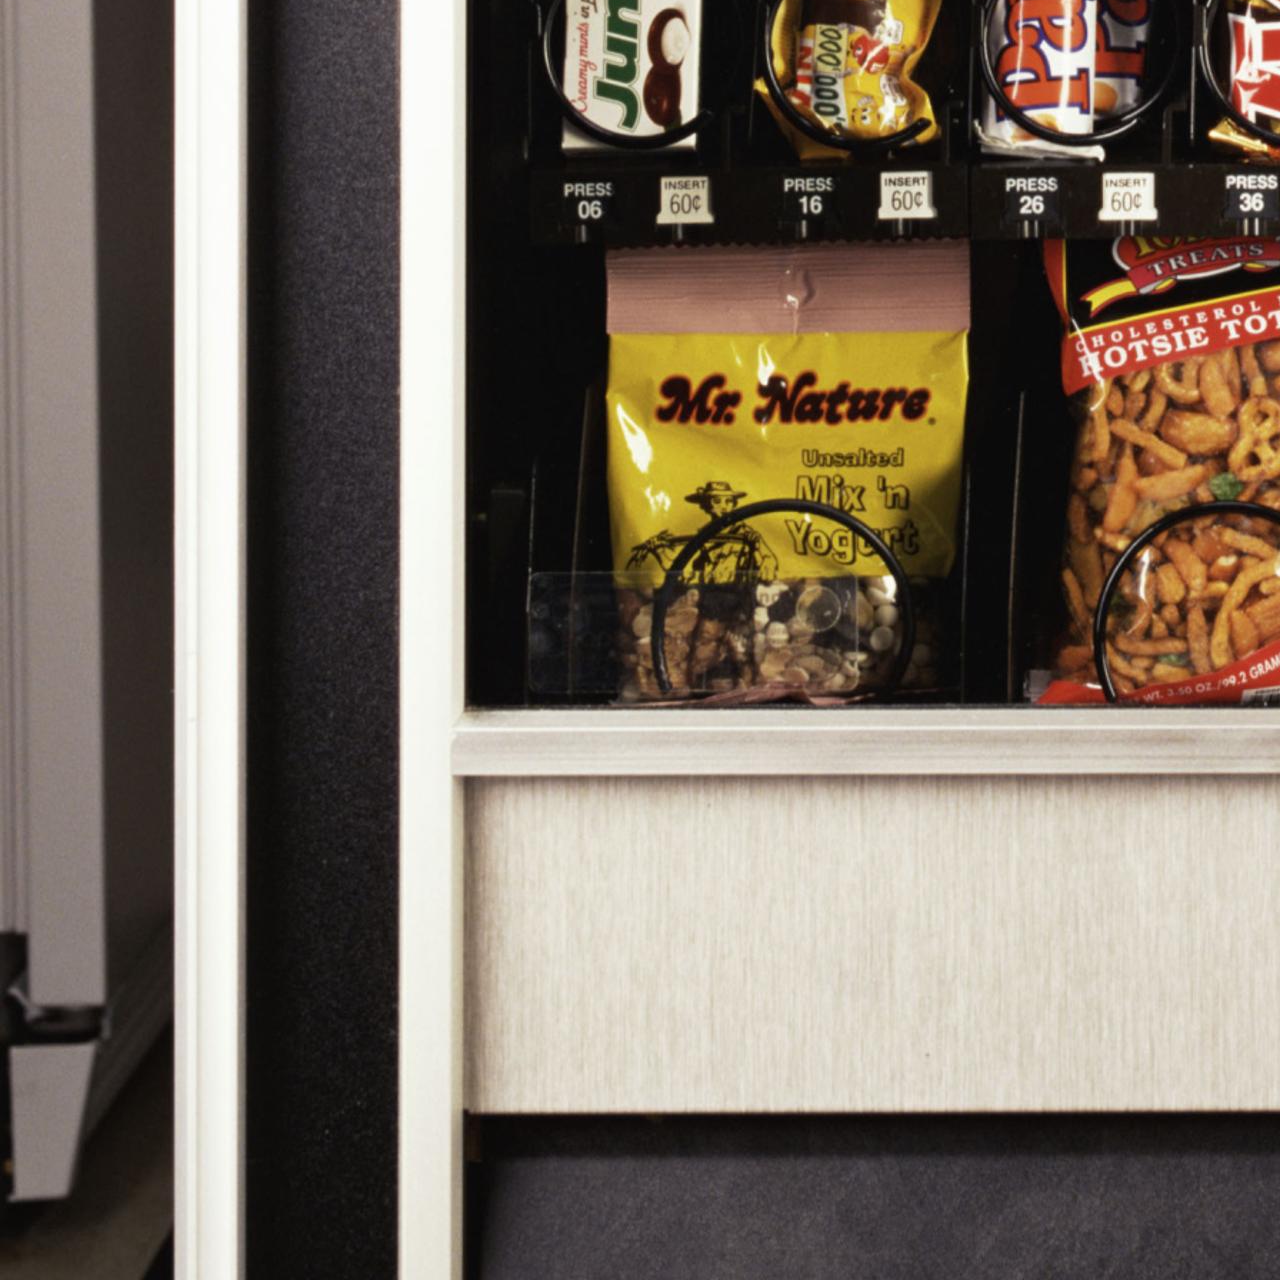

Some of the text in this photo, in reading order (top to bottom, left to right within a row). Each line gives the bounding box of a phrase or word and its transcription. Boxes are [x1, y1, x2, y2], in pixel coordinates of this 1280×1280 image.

[670, 194, 700, 215] 60¢
[1147, 244, 1264, 277] TREATS
[1076, 301, 1261, 353] CHOLESTEROL
[656, 371, 931, 425] Mr. Nature
[802, 449, 903, 467] Unsalted
[797, 476, 865, 512] Mix
